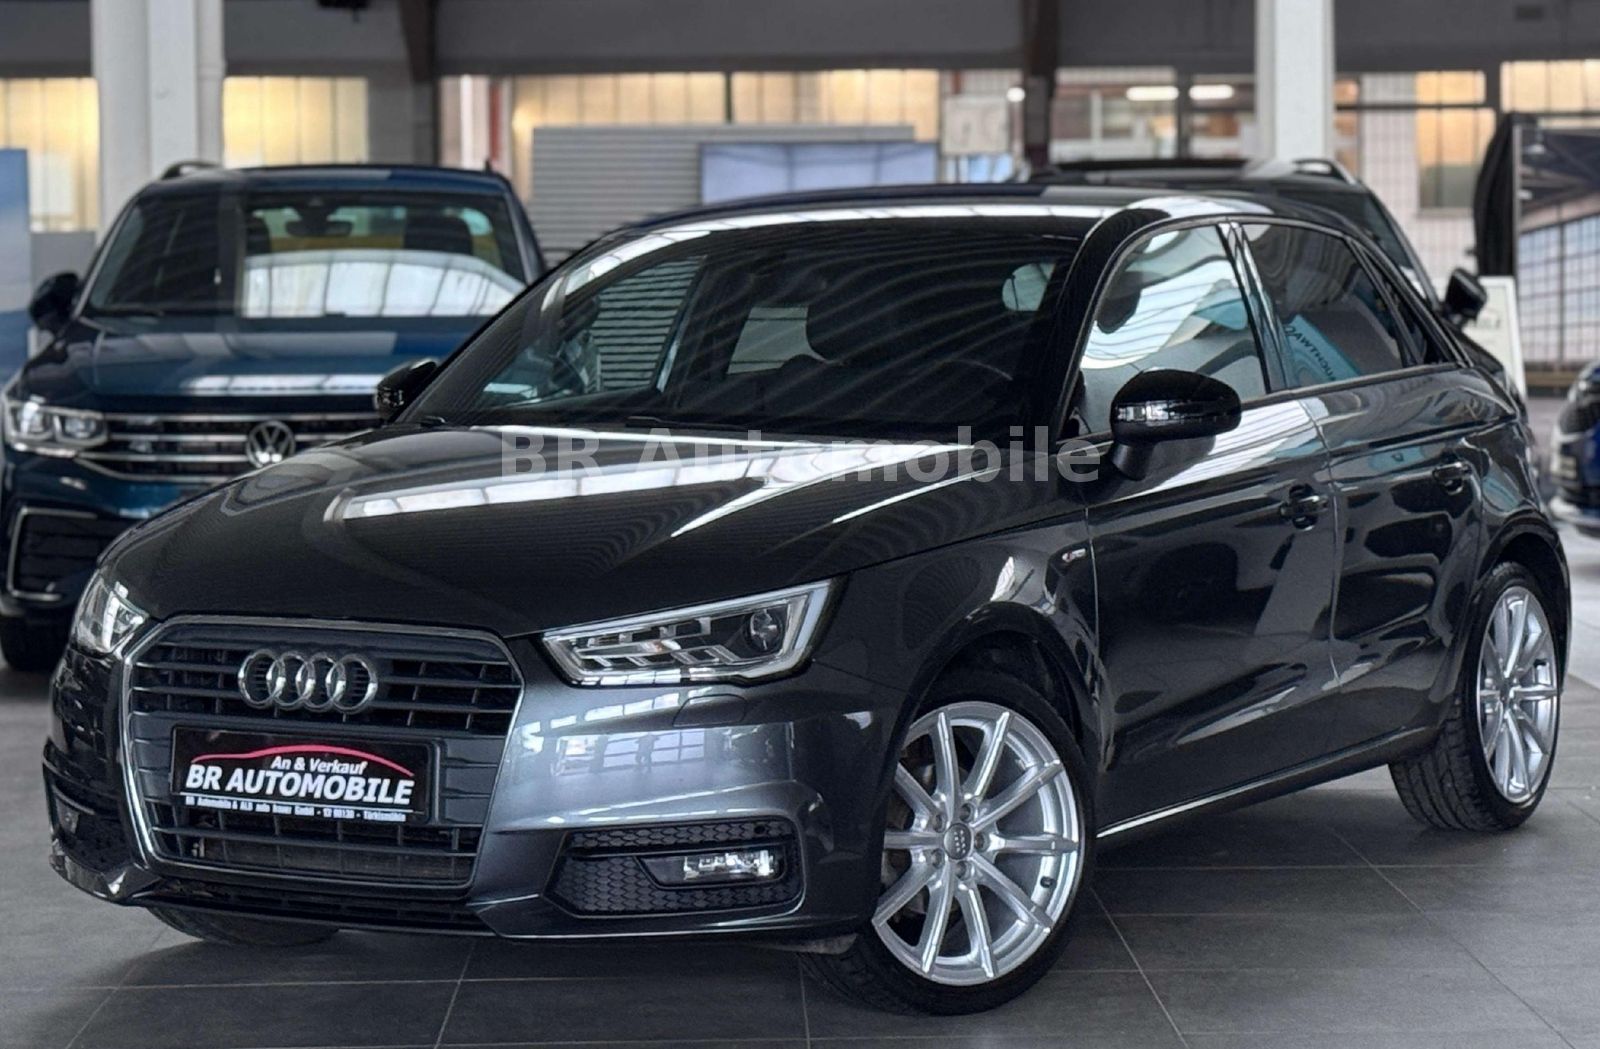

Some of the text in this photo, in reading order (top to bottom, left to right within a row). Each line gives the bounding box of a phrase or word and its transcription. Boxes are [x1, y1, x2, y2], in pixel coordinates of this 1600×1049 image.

[271, 755, 368, 775] An & Verkauf
[185, 763, 416, 806] BR AUTOMOBILE
